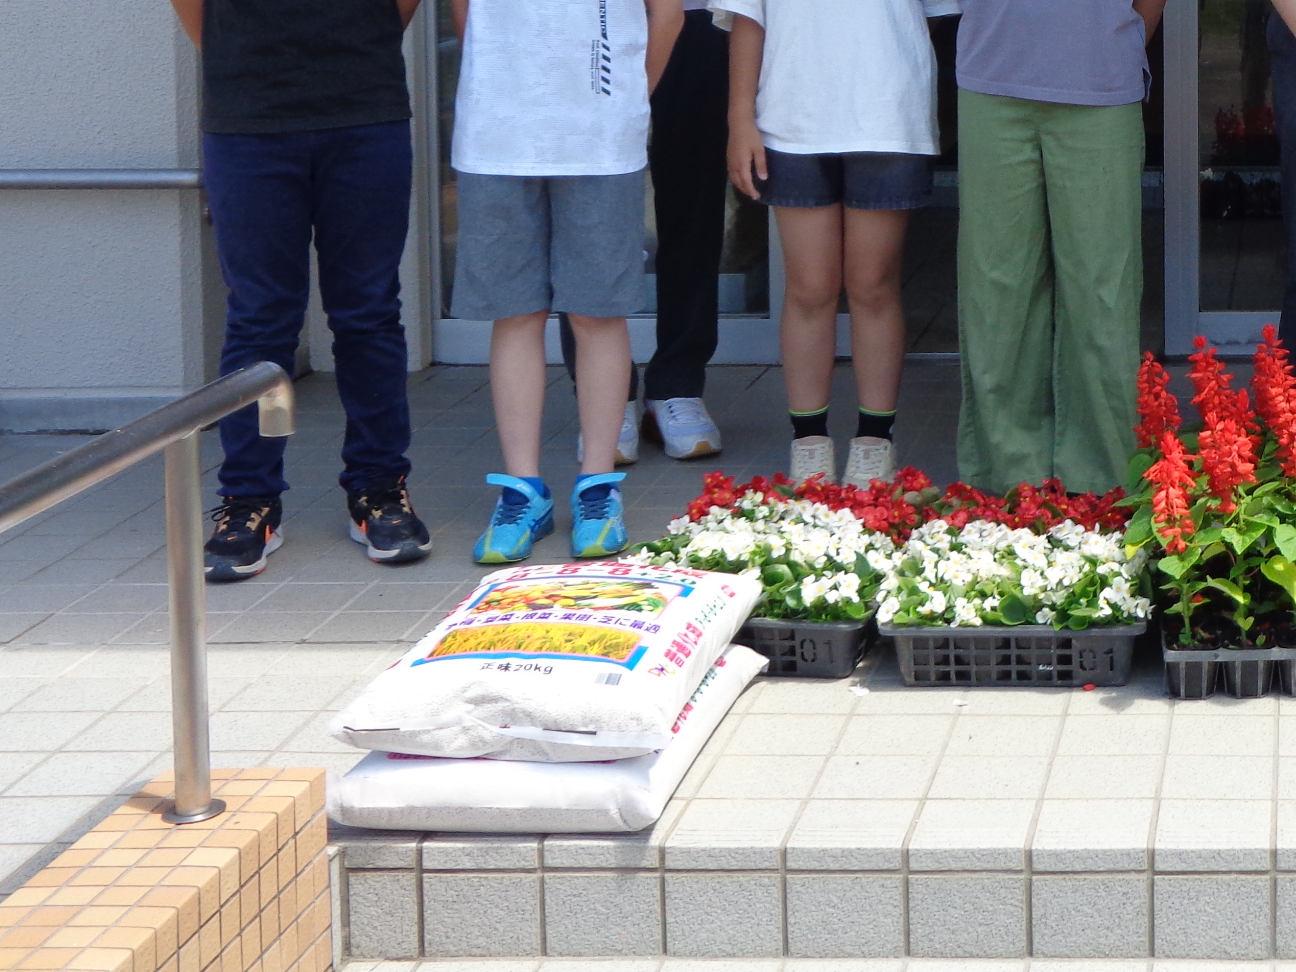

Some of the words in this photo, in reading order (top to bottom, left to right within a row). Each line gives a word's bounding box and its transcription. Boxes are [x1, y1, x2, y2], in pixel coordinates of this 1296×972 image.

[800, 639, 836, 665] 01
[1078, 647, 1116, 672] 01
[480, 661, 553, 674] 正味20kg
